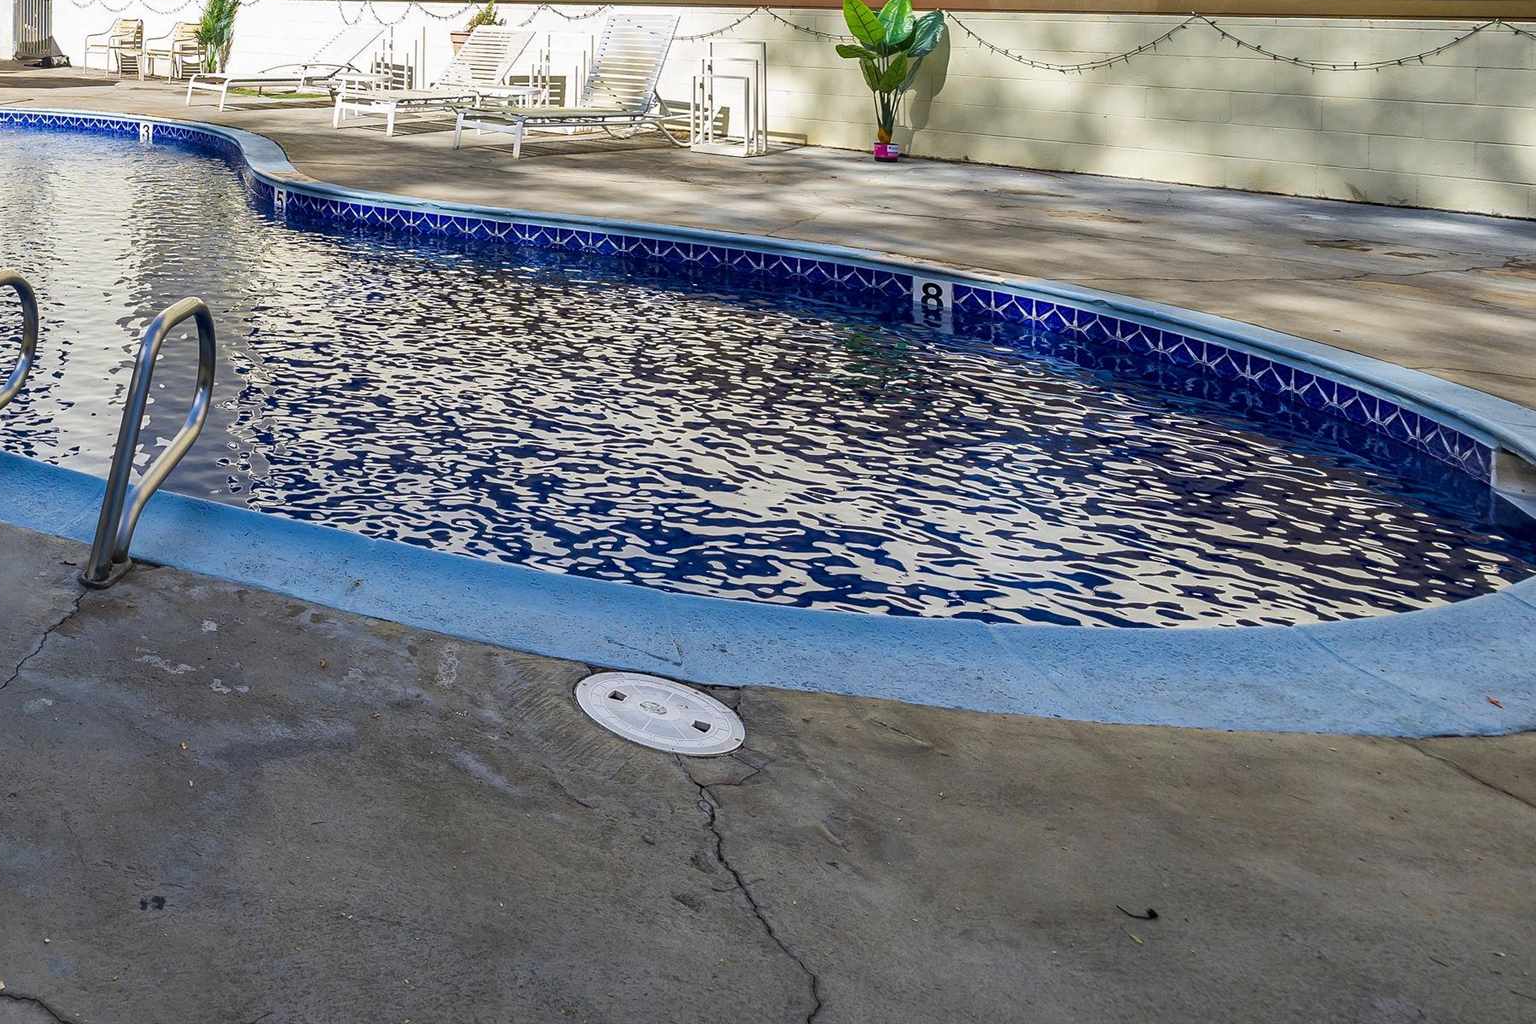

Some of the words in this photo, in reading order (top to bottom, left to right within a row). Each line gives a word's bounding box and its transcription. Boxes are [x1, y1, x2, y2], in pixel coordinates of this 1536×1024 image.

[142, 124, 150, 142] 3
[276, 190, 284, 209] 5
[921, 282, 944, 312] 8
